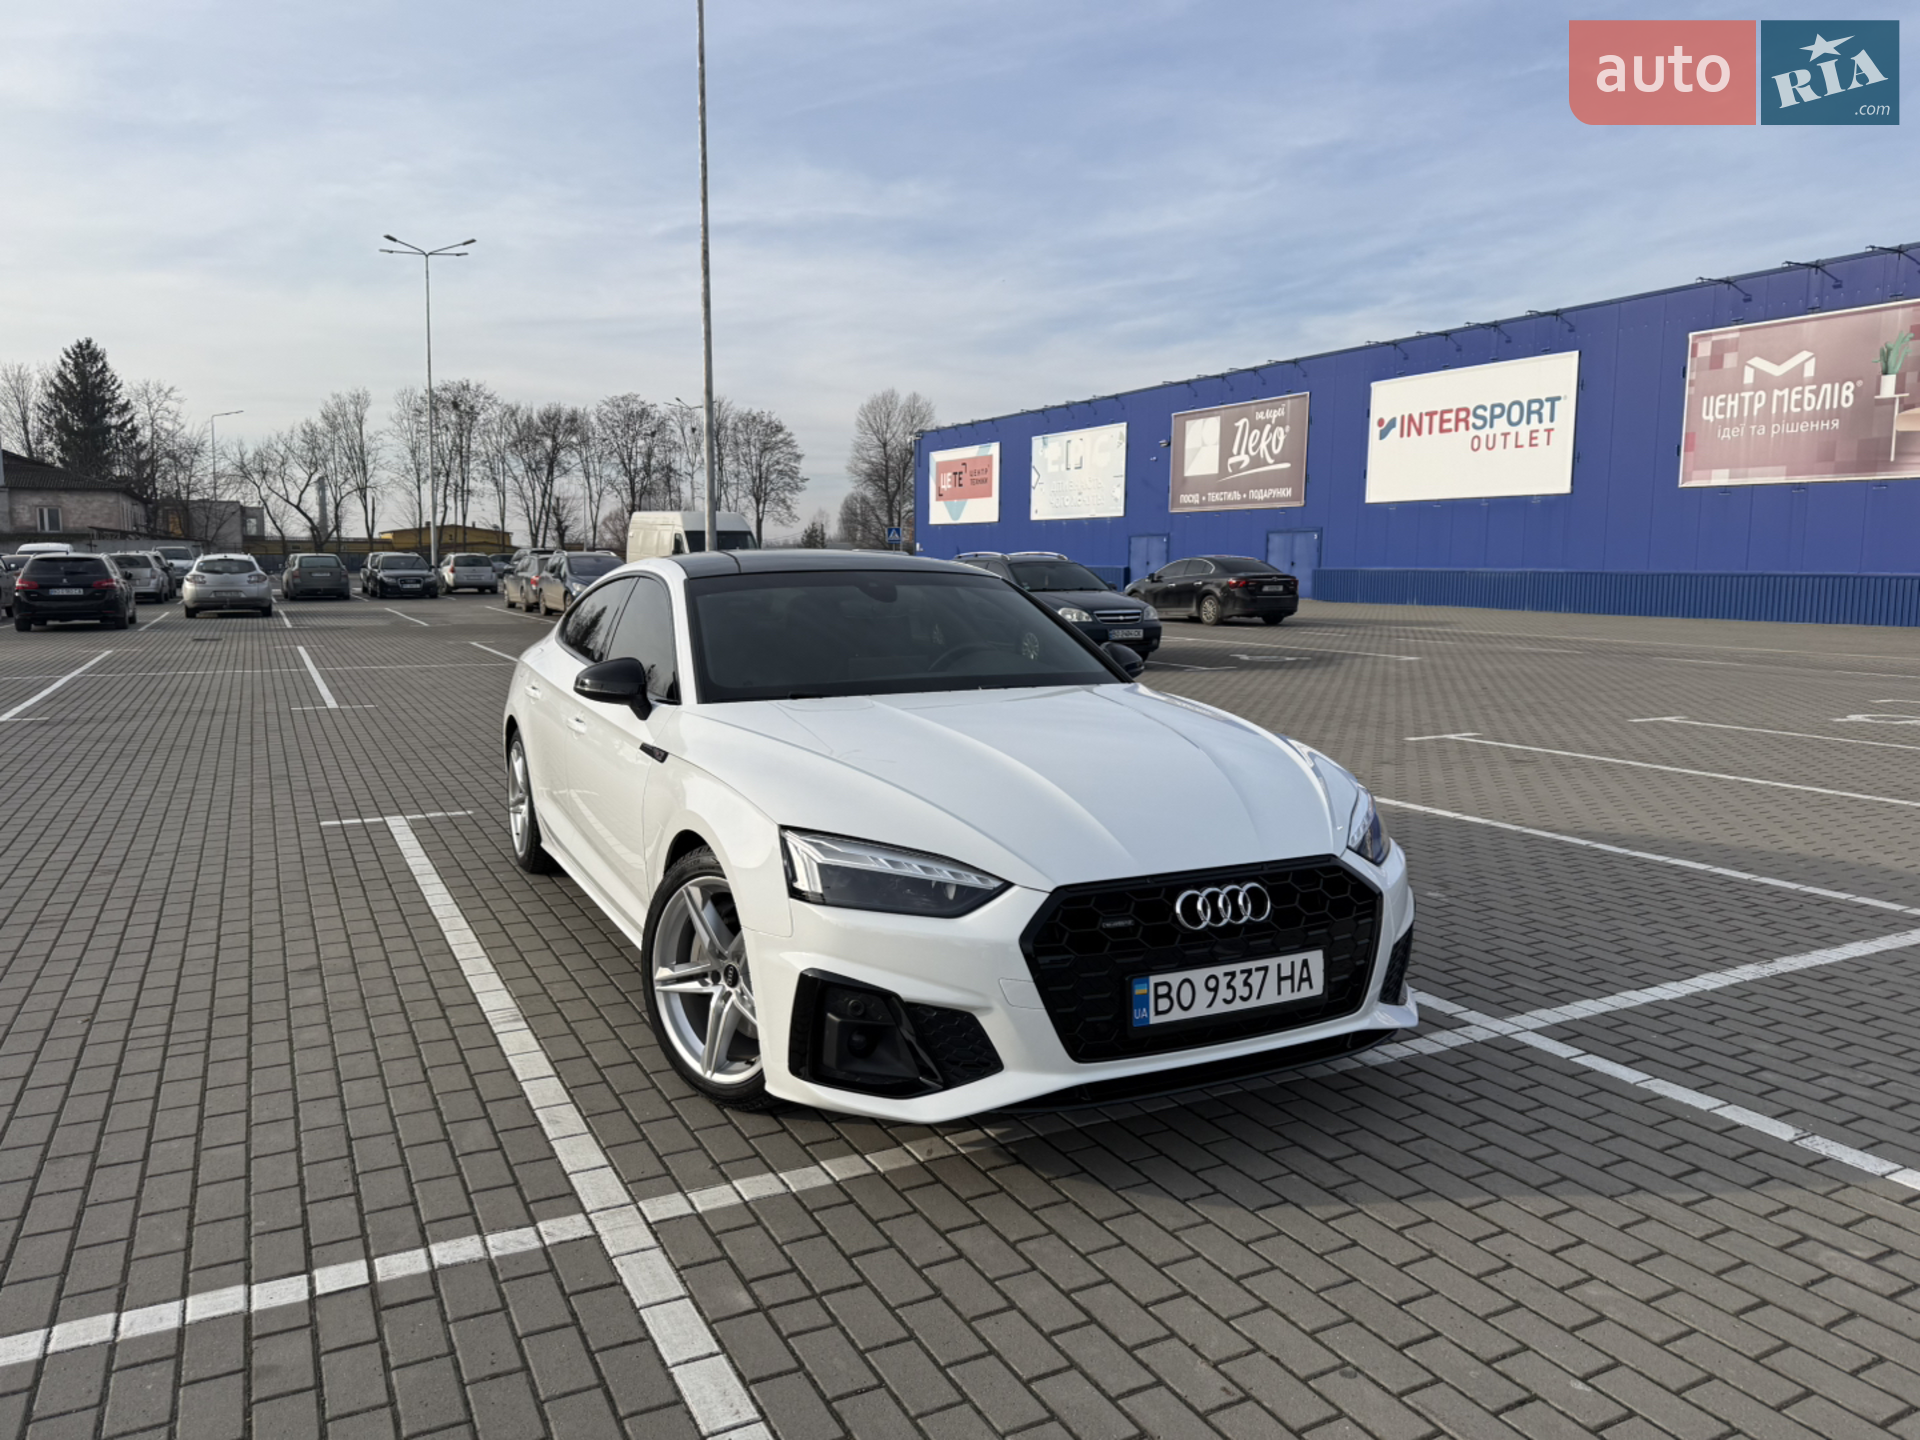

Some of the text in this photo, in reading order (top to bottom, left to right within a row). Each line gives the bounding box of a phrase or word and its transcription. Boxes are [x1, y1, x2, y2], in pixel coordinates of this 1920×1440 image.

[1399, 395, 1562, 439] INTERSPORT
[1702, 380, 1855, 422] ЦЕНТР МЕБЛІВ
[1227, 417, 1288, 473] Деко
[1470, 428, 1555, 452] OUTLET
[1717, 418, 1840, 440] ідеї та рішення
[1180, 487, 1292, 504] ПОСУД ТЕКСТИЛЬ ПОДАРУНКИ
[1153, 958, 1313, 1016] BO 9337 HA
[1134, 1008, 1148, 1020] UA
